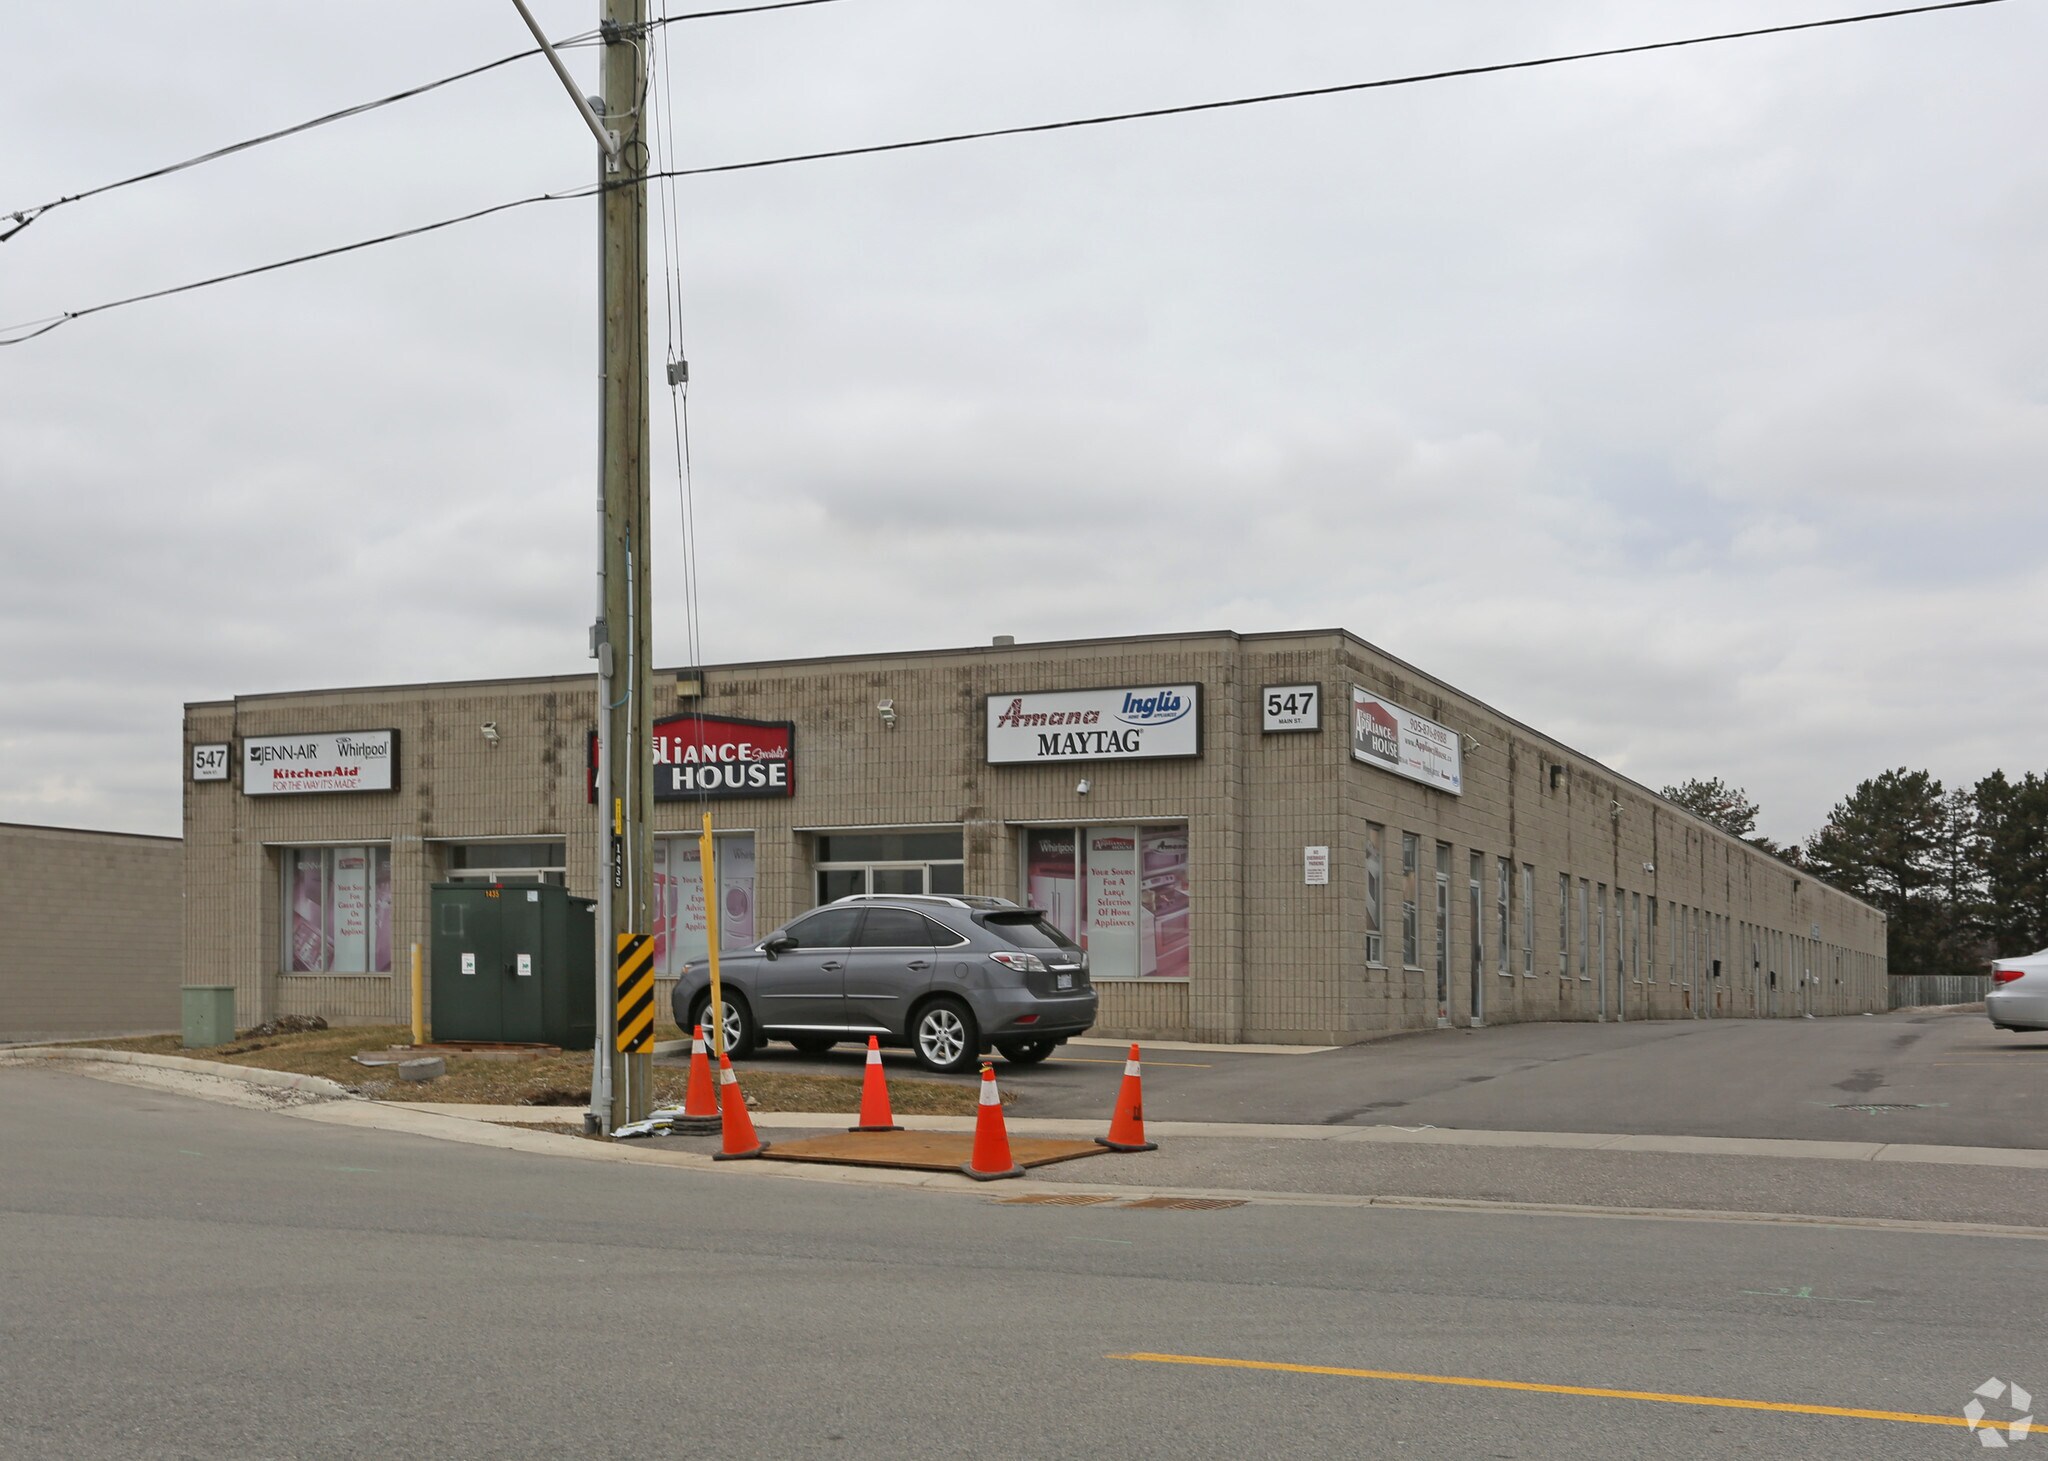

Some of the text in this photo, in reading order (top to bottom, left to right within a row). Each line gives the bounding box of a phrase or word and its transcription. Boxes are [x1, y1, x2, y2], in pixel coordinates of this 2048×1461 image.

[997, 699, 1100, 728] Amana
[1122, 691, 1181, 718] Inglis
[1268, 693, 1314, 716] 547
[260, 741, 387, 766] JENN-AIR Whirlpool
[1037, 729, 1140, 756] MAYTAG
[1372, 735, 1398, 758] HOUSE
[196, 751, 225, 768] 547
[273, 766, 358, 779] KitchenAid
[672, 763, 787, 790] HOUSE
[273, 781, 287, 791] FOR
[288, 780, 302, 790] THE
[303, 780, 320, 789] WAY
[1039, 841, 1075, 854] Whirlpoo
